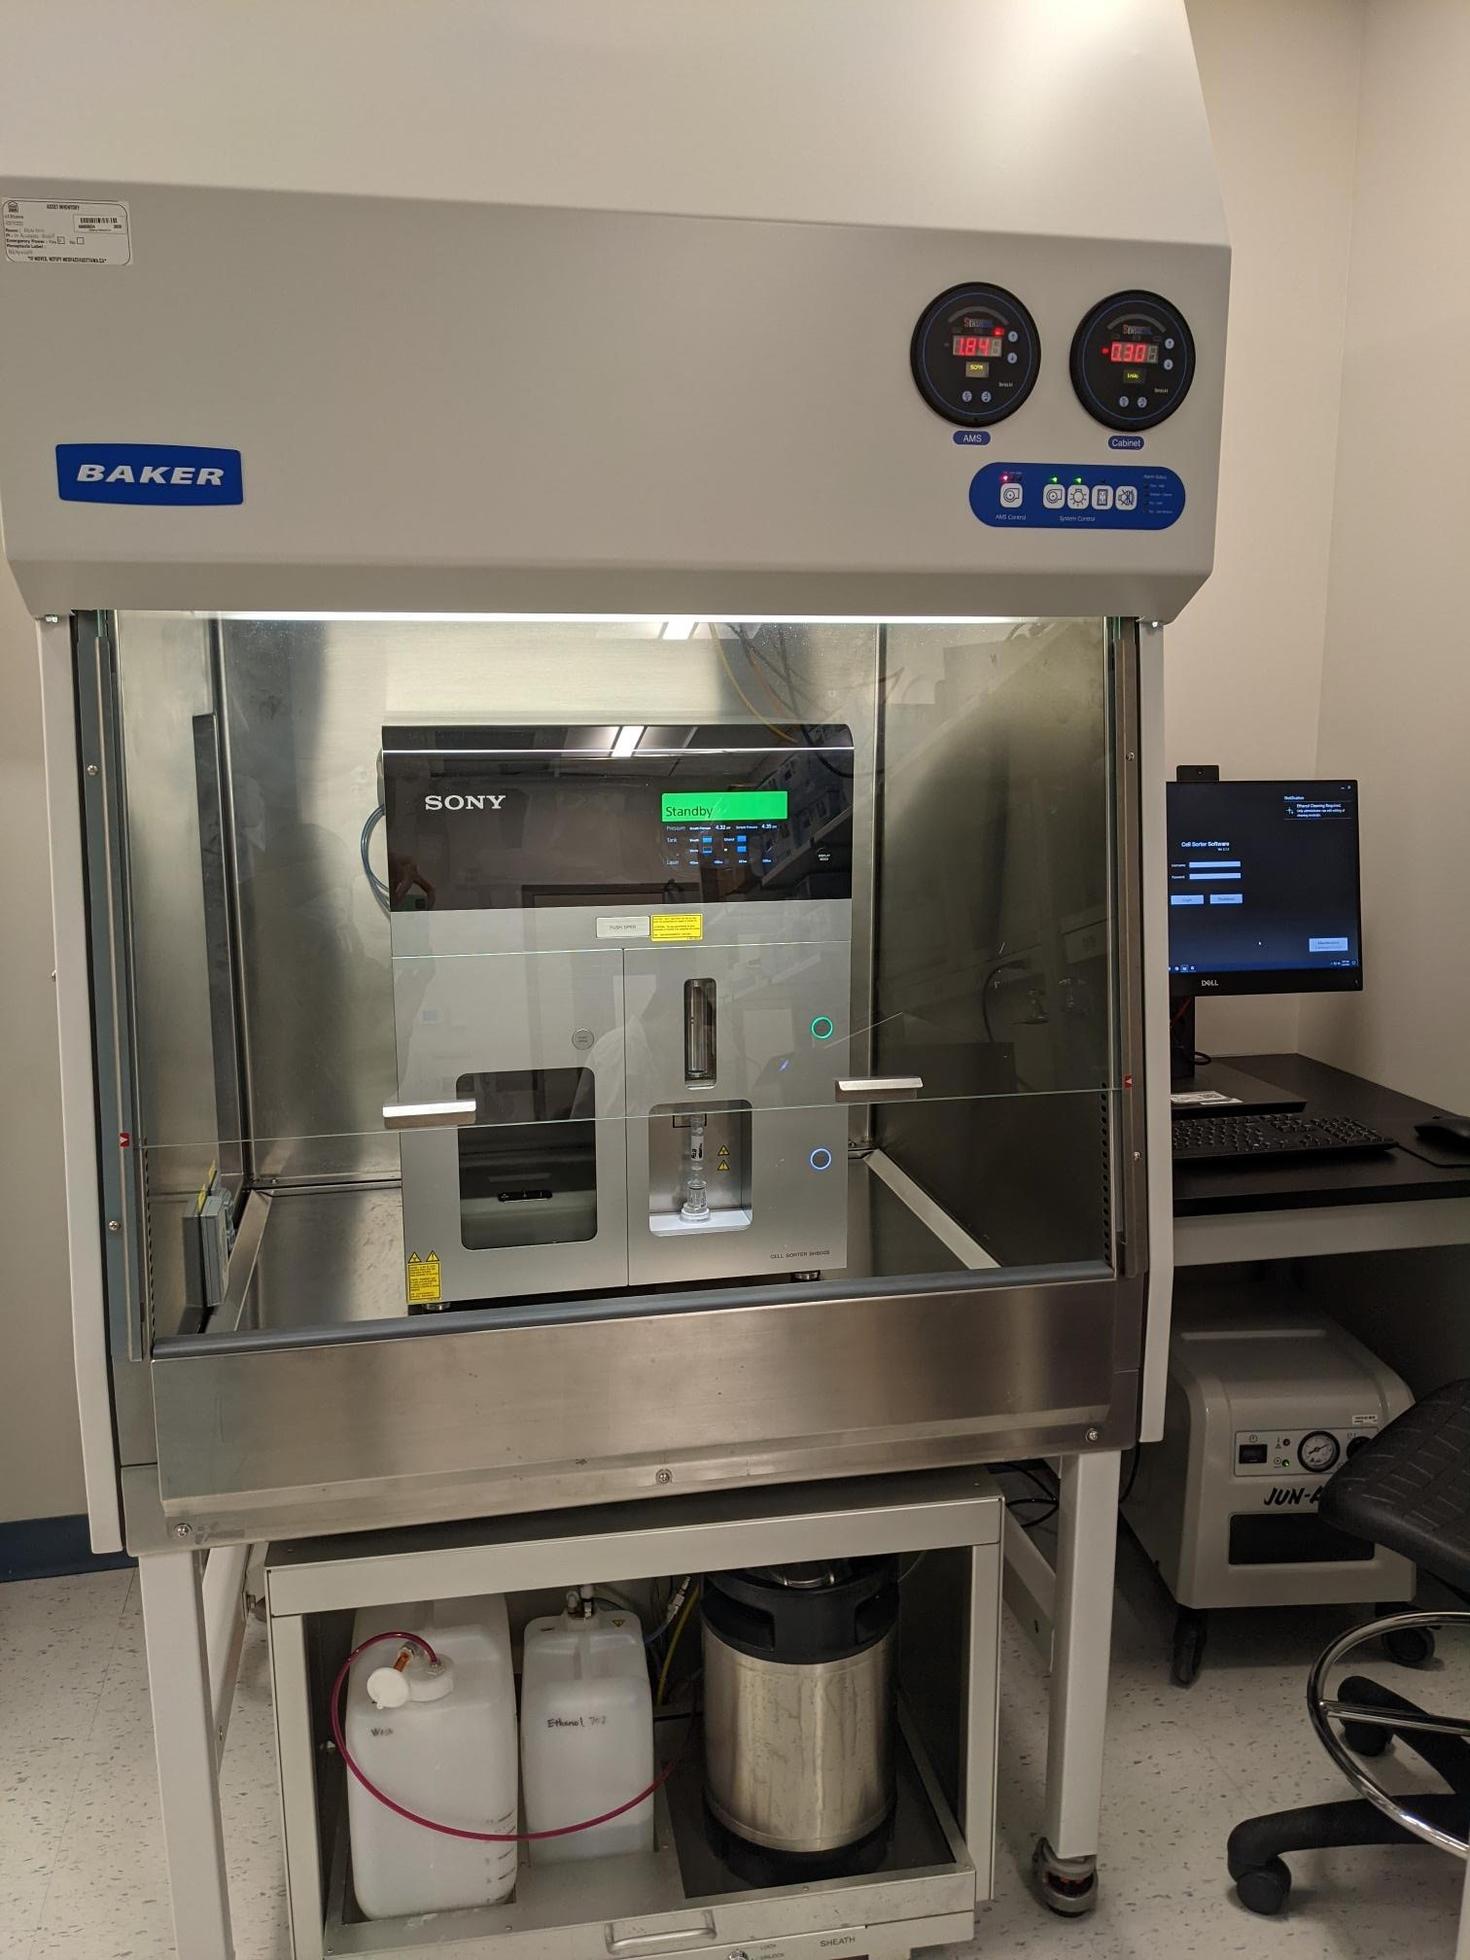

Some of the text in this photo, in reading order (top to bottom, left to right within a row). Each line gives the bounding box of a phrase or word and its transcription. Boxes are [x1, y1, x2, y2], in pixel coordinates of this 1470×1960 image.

[963, 434, 982, 443] AMS
[1112, 438, 1141, 447] Cabinet
[76, 464, 224, 486] BAKER
[424, 795, 506, 810] SONY
[666, 806, 713, 818] Standby
[1201, 979, 1219, 987] DELL
[547, 1716, 585, 1728] Ethanol
[820, 1936, 856, 1947] SHEATH
